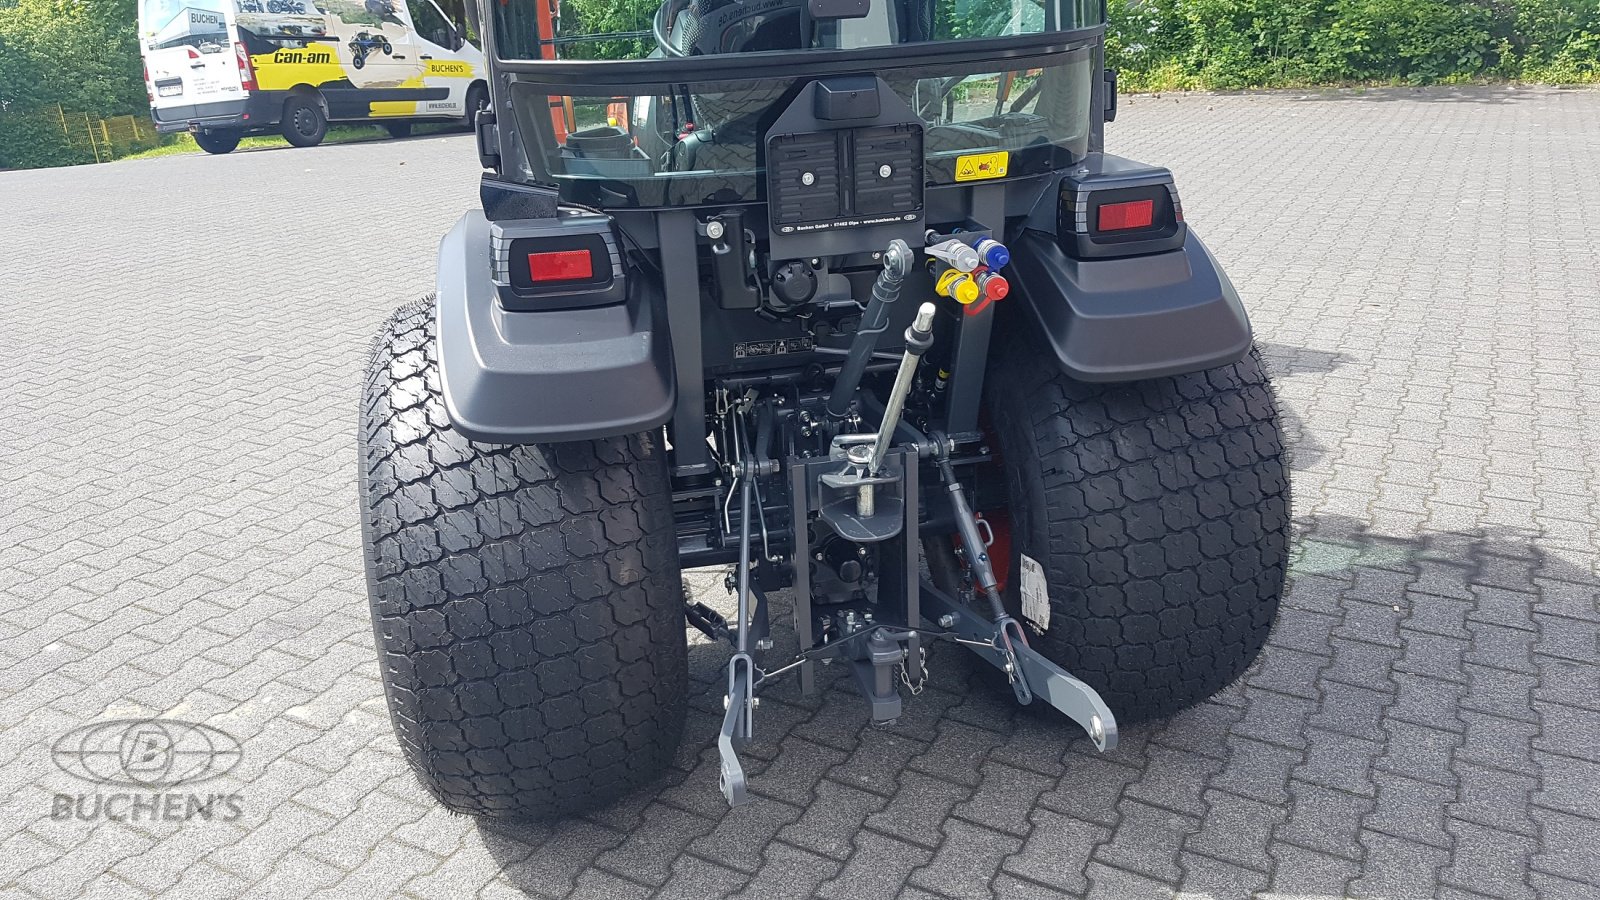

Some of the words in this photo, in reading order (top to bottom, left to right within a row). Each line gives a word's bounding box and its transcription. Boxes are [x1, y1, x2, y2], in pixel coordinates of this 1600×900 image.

[191, 12, 218, 24] BUCHEN
[274, 52, 330, 64] can-am
[431, 64, 464, 73] BUCHEN'S
